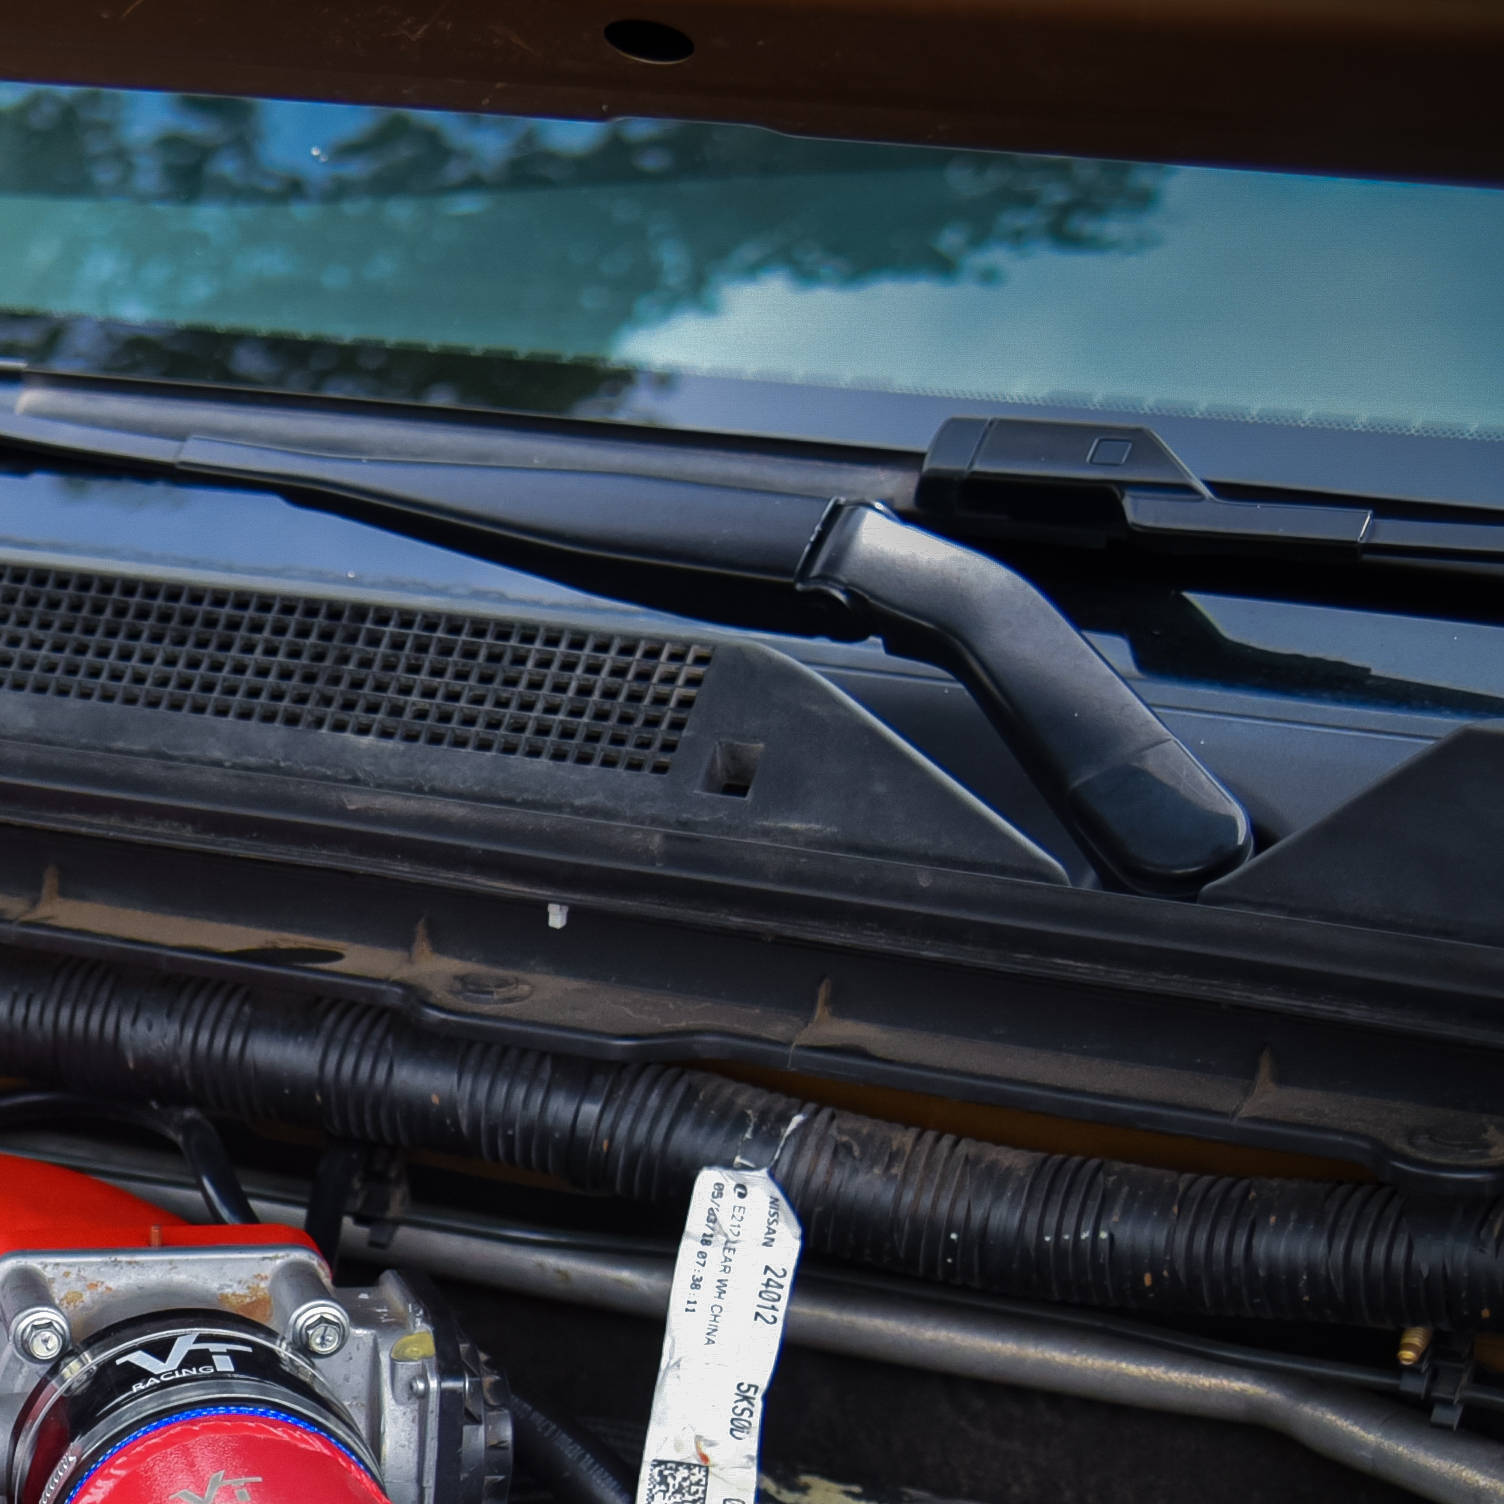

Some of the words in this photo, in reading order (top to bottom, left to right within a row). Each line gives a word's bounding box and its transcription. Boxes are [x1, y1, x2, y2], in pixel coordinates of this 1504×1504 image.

[762, 1195, 780, 1248] NISSAN
[720, 1238, 738, 1274] LEAR
[754, 1264, 788, 1326] 24012
[703, 1303, 723, 1347] CHINA
[130, 1365, 215, 1393] RACING
